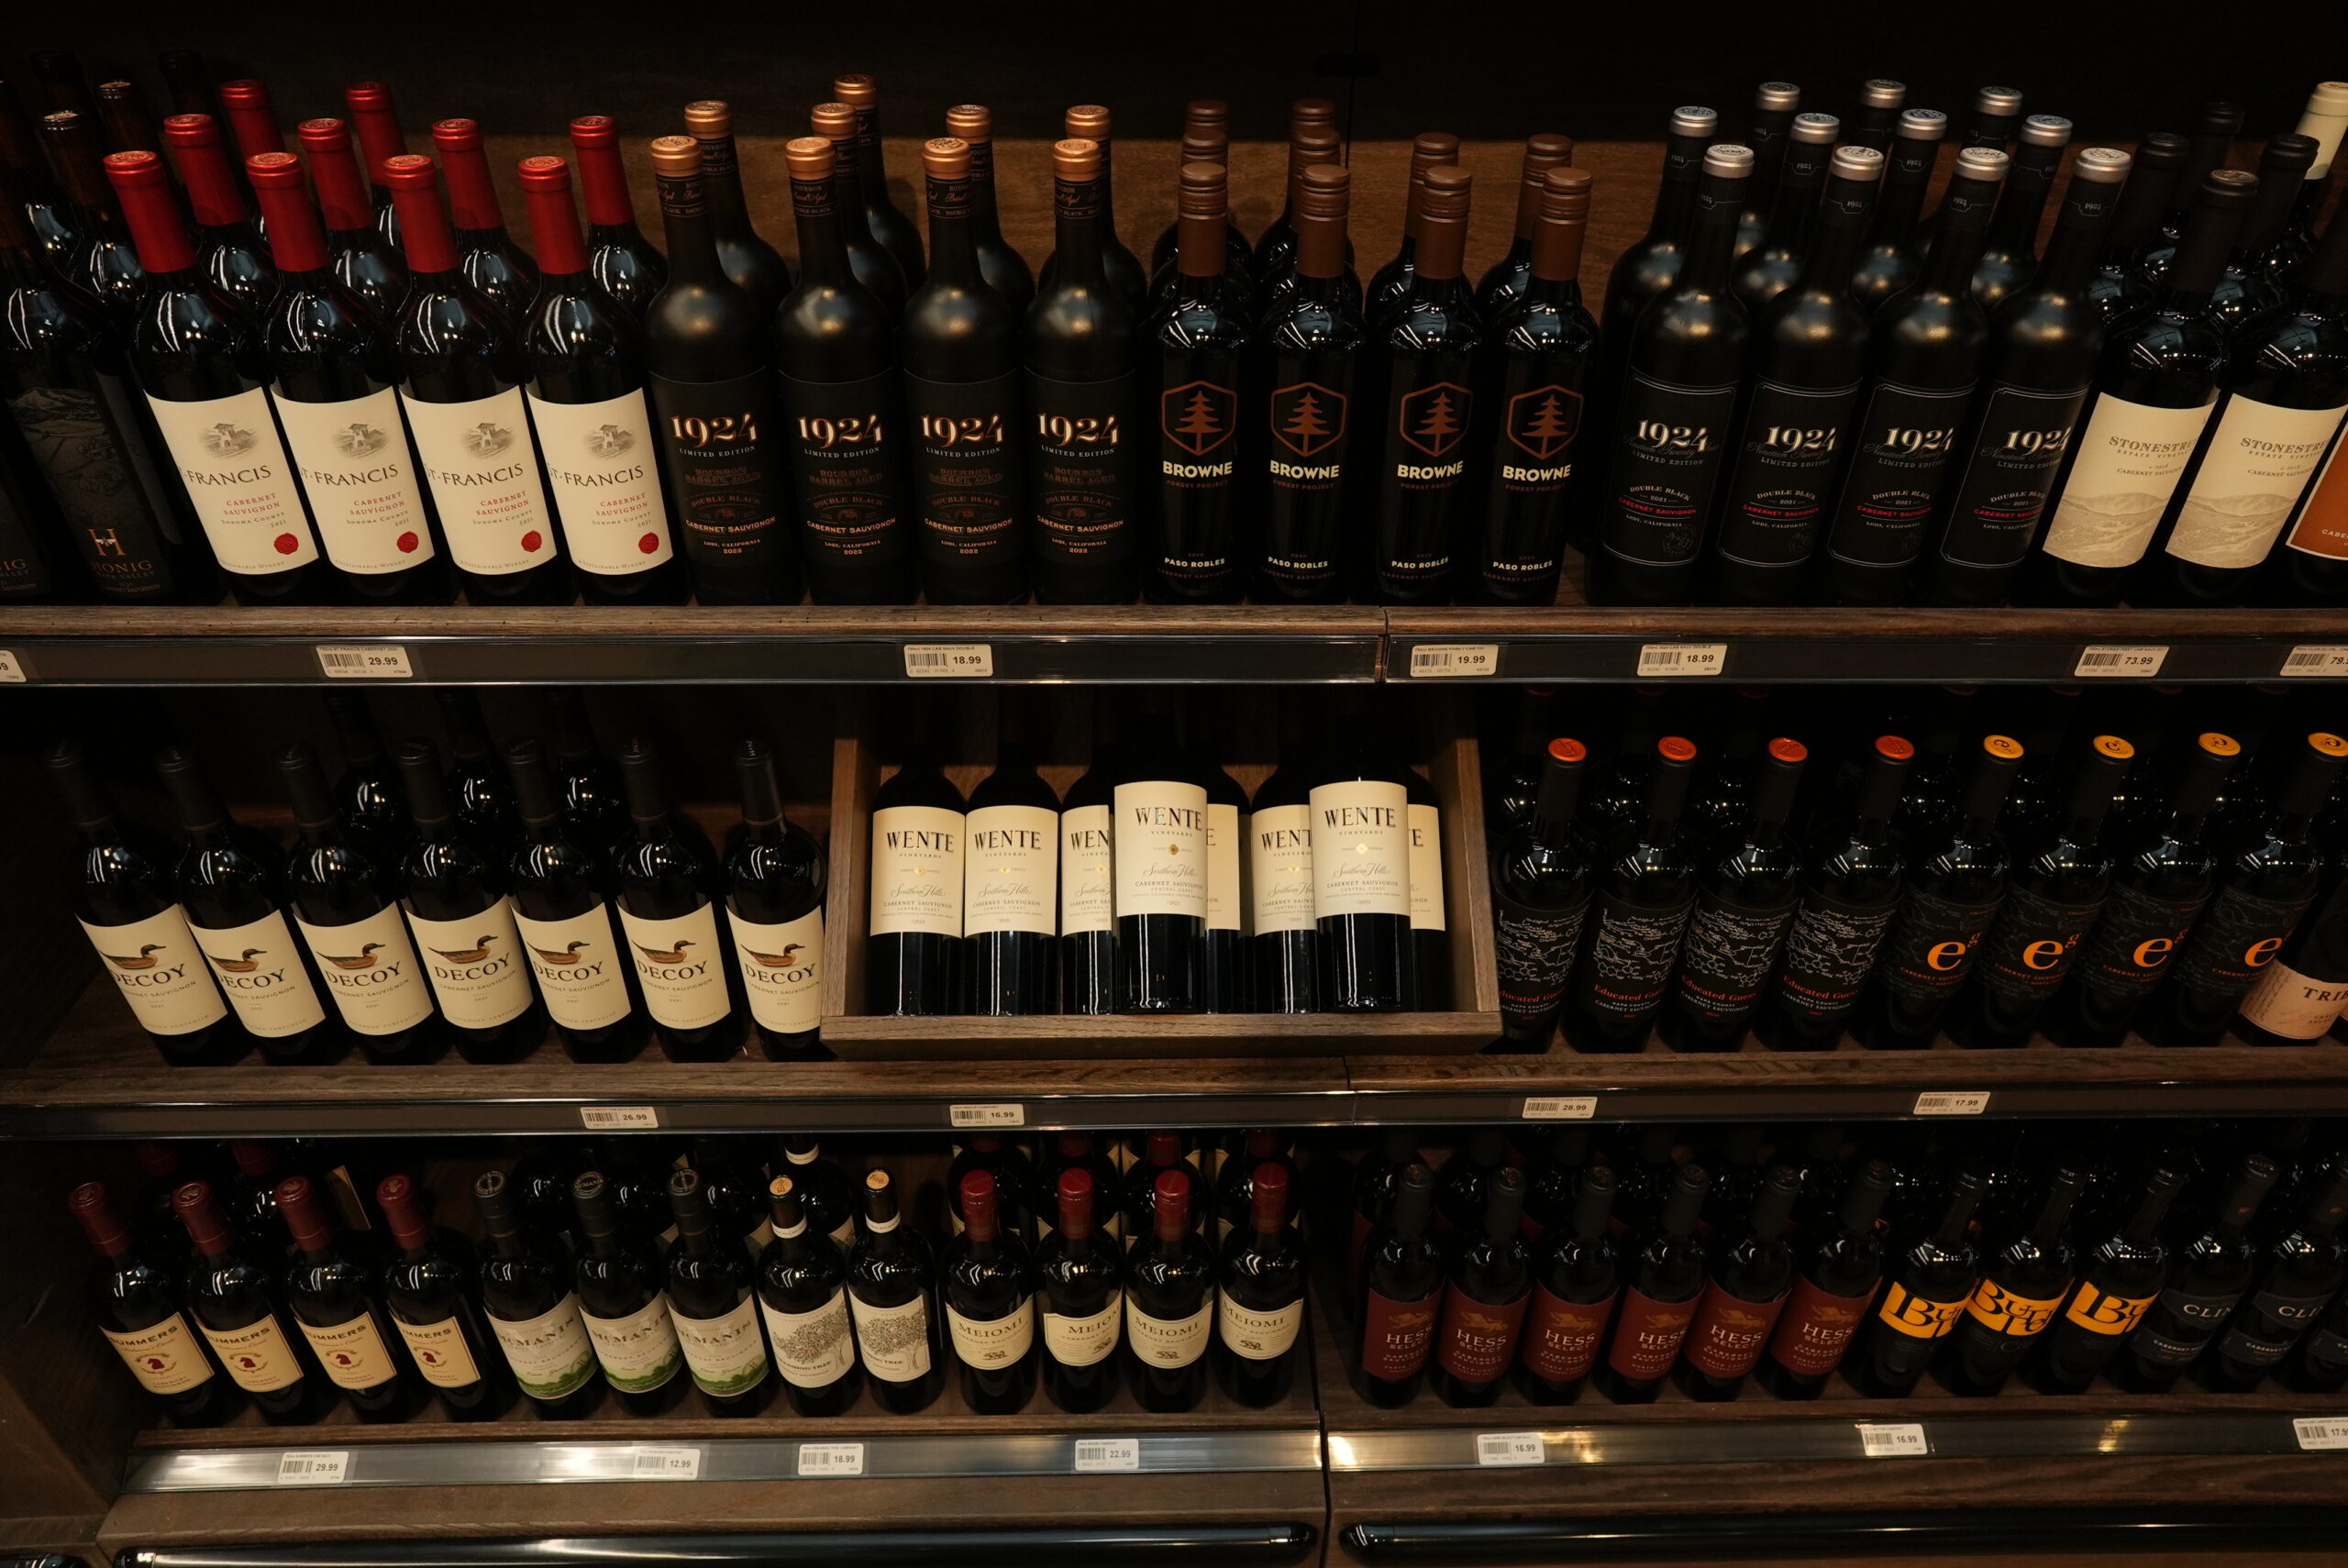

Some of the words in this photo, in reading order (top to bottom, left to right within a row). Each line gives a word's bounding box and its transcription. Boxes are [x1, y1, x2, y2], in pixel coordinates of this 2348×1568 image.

[670, 411, 759, 448] 1924
[798, 413, 883, 449] 1924
[920, 413, 1004, 447] 1924
[1037, 412, 1119, 447] 1924
[1637, 418, 1709, 454] 1924
[1767, 425, 1836, 453] 1924
[1882, 426, 1955, 454] 1924
[680, 447, 714, 458] LIMITED
[719, 444, 756, 458] EDITION
[804, 448, 840, 458] LIMITED
[844, 447, 880, 458] EDITION
[926, 447, 960, 458] LIMITED
[965, 447, 1000, 458] EDITION
[1041, 445, 1075, 457] LIMITED
[1080, 447, 1114, 458] EDITION
[1633, 451, 1666, 464] LIMITED
[2117, 449, 2149, 458] ESTATE
[2248, 450, 2283, 458] ESTATE
[1269, 459, 1339, 480] BROWNE
[1761, 457, 1794, 467] LIMITED
[1878, 458, 1913, 468] LIMITED
[1997, 460, 2034, 469] LIMITED
[1162, 460, 1233, 480] BROWNE
[1397, 460, 1464, 480] BROWNE
[1502, 463, 1571, 481] BROWNE
[1167, 480, 1193, 488] FOREST
[1196, 480, 1230, 490] PROJECT
[1505, 483, 1533, 492] FOREST
[1536, 482, 1567, 492] PROJECT
[227, 493, 276, 506] CABERNET
[354, 492, 402, 506] CABERNET
[481, 491, 526, 506] CABERNET
[601, 492, 646, 507] CABERNET
[691, 497, 725, 507] DOUBLE
[730, 494, 761, 505] BLACK
[814, 496, 848, 507] DOUBLE
[852, 496, 883, 505] BLACK
[1667, 487, 1690, 502] BLACK
[1757, 491, 1793, 499] DOUBLE
[1796, 490, 1816, 501] BLACK
[1872, 491, 1907, 500] DOUBLE
[1910, 490, 1930, 500] BLACK
[1990, 491, 2026, 502] DOUBLE
[224, 502, 281, 516] SAUVIGNON
[350, 501, 404, 515] SAUVIGNON
[477, 499, 529, 515] SAUVIGNON
[596, 501, 648, 516] SAUVIGNON
[271, 519, 286, 528] 2021
[394, 518, 409, 526] 2021
[685, 519, 725, 533] CABERNET
[728, 516, 776, 533] SAUVIGNON
[806, 520, 847, 534] CABERNET
[849, 518, 896, 533] SAUVIGNON
[925, 518, 964, 533] CABERNET
[967, 517, 1013, 533] SAUVIGNON
[1037, 515, 1076, 532] CABERNET
[1079, 519, 1124, 532] SAUVIGNON
[1165, 558, 1189, 567] PASO
[1191, 558, 1225, 567] ROBLES
[1268, 557, 1292, 567] PASO
[1294, 559, 1328, 569] ROBLES
[1391, 560, 1416, 569] PASO
[1419, 556, 1448, 568] ROBLES
[1492, 561, 1518, 569] PASO
[1520, 559, 1552, 570] ROBLES
[368, 657, 398, 666] 29.99
[953, 656, 981, 665] 18.99
[1457, 656, 1486, 664] 19.99
[1687, 655, 1714, 663] 18.99
[2124, 657, 2154, 665] 73.99
[1135, 807, 1202, 831] WENTE
[1325, 807, 1396, 828] WENTE
[887, 830, 955, 853] WENTE
[974, 830, 1041, 852] WENTE
[1071, 829, 1109, 850] WEN
[1262, 829, 1312, 851] WENT
[325, 961, 402, 988] DECOY
[435, 953, 511, 981] DECOY
[534, 962, 604, 982] DECOY
[637, 960, 708, 981] DECOY
[745, 963, 815, 984] DECOY
[1594, 985, 1640, 1002] Educated
[1681, 975, 1726, 1001] Educated
[1729, 991, 1758, 1002] Guess
[1781, 975, 1829, 999] Educated
[1833, 990, 1858, 999] Guess
[1501, 988, 1539, 1004] ducated
[1224, 1303, 1284, 1328] MEIOMI
[958, 1319, 1022, 1337] MEIOMI
[1135, 1316, 1199, 1337] MEIOMI
[1802, 1323, 1855, 1342] HESS
[1387, 1326, 1433, 1344] HESS
[1457, 1329, 1507, 1347] HESS
[1545, 1329, 1595, 1348] HESS
[1639, 1327, 1687, 1344] HESS
[1711, 1325, 1762, 1344] HESS
[1805, 1336, 1846, 1346] SELECT
[1460, 1341, 1501, 1353] SELECT
[1548, 1342, 1589, 1352] SELECT
[1712, 1337, 1758, 1349] SELECT
[1897, 1435, 1917, 1443] 16.99
[1110, 1450, 1131, 1458] 22.99
[1515, 1444, 1535, 1452] 16.99
[670, 1460, 692, 1468] 12.99
[834, 1455, 855, 1463] 18.99
[316, 1463, 338, 1472] 29.99
